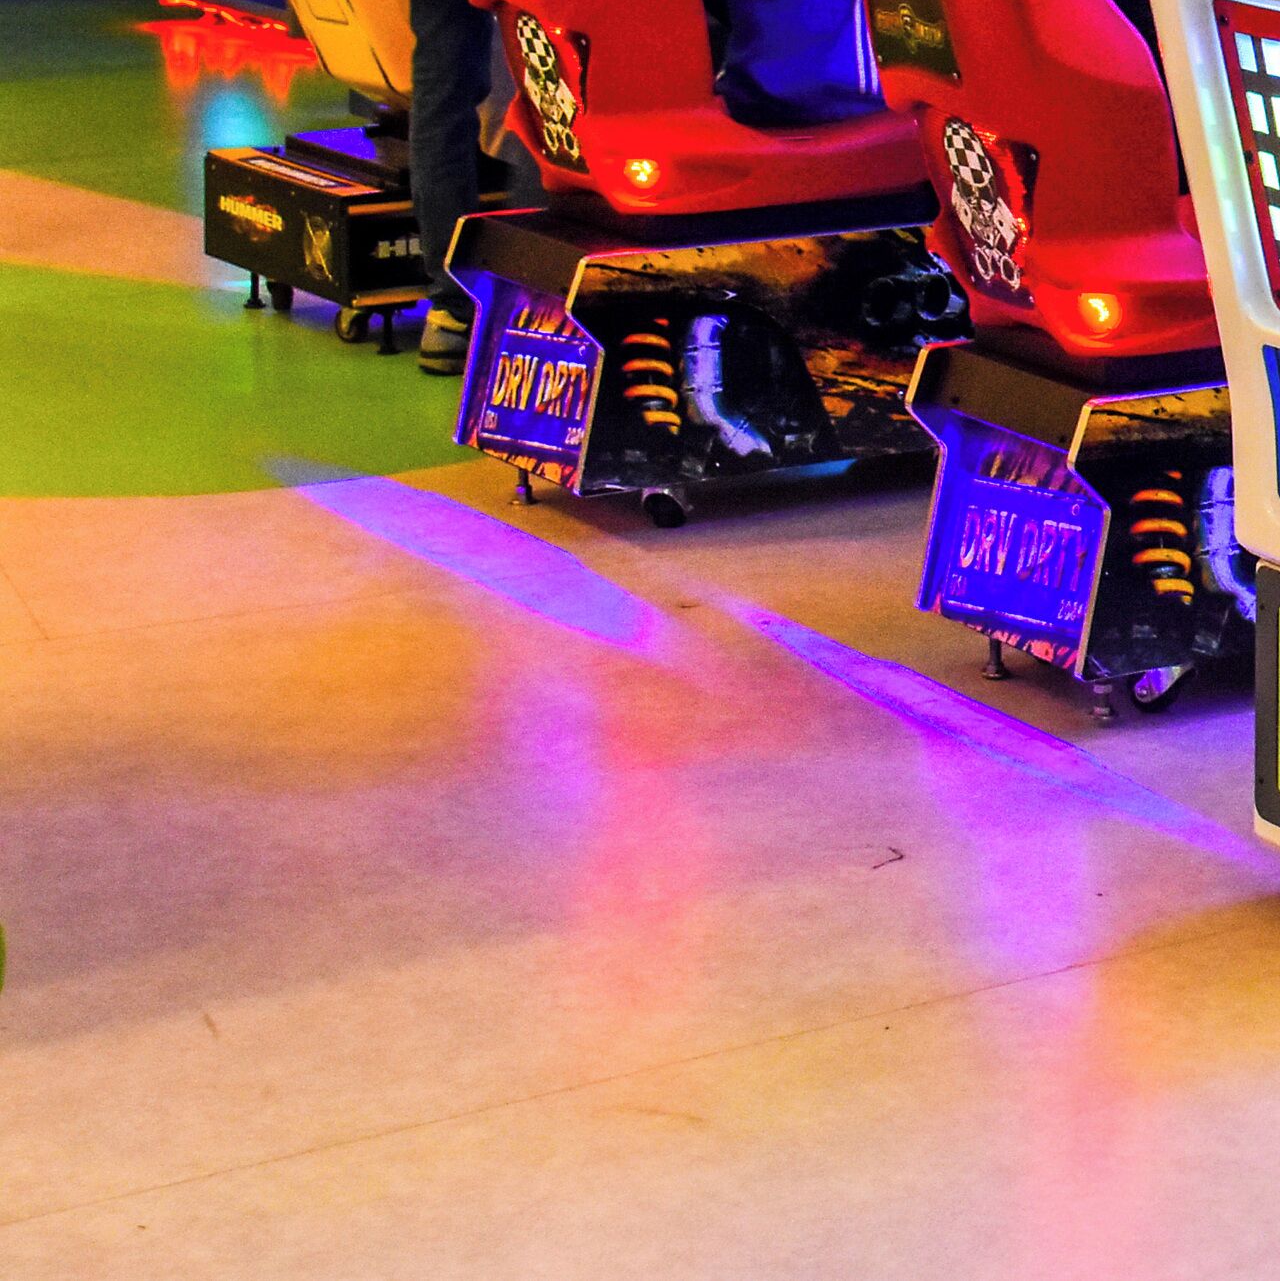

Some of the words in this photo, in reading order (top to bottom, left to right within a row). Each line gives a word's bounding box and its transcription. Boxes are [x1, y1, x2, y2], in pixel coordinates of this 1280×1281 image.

[219, 195, 284, 232] HUMMER
[490, 351, 539, 411] DRV
[959, 505, 1018, 576] DRV
